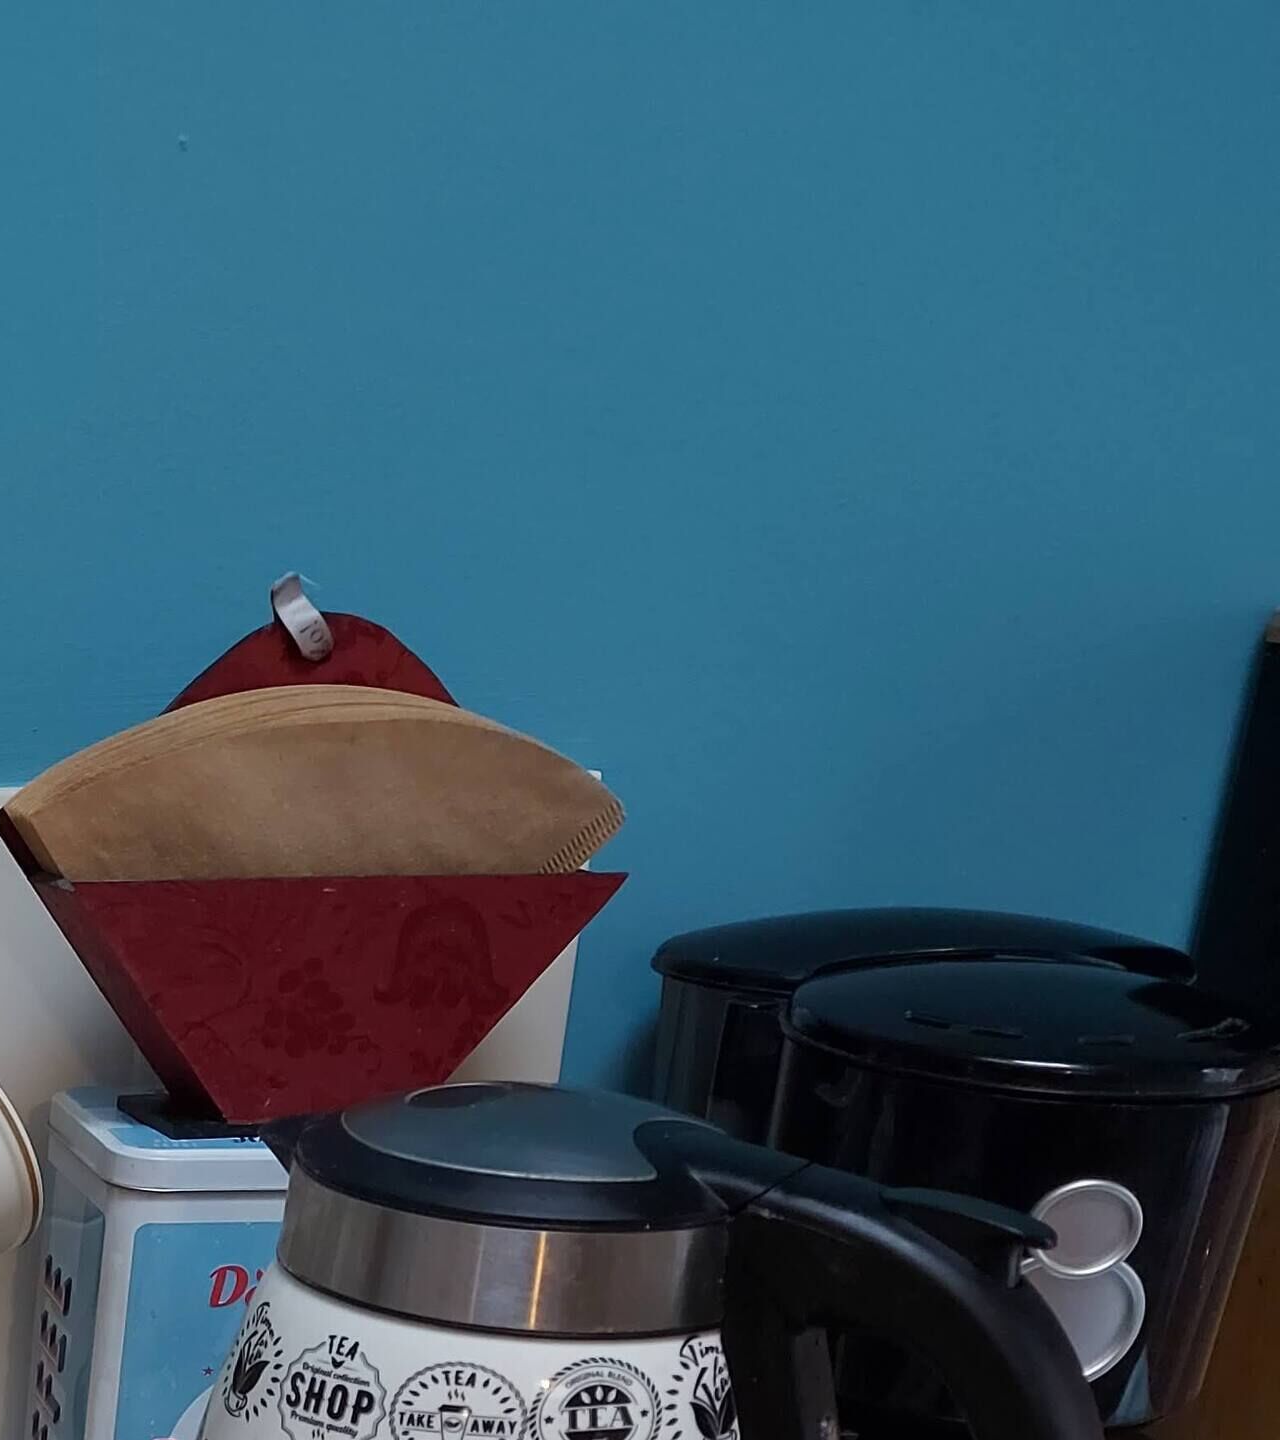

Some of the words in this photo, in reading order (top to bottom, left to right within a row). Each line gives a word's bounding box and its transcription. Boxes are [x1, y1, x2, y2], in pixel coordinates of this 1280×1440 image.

[327, 1335, 359, 1361] TEA
[680, 1335, 724, 1367] Tim
[442, 1370, 477, 1389] TEA
[285, 1371, 375, 1426] SHOP
[398, 1411, 435, 1430] TAKE
[470, 1418, 518, 1435] AWAY
[560, 1405, 634, 1431] TEA
